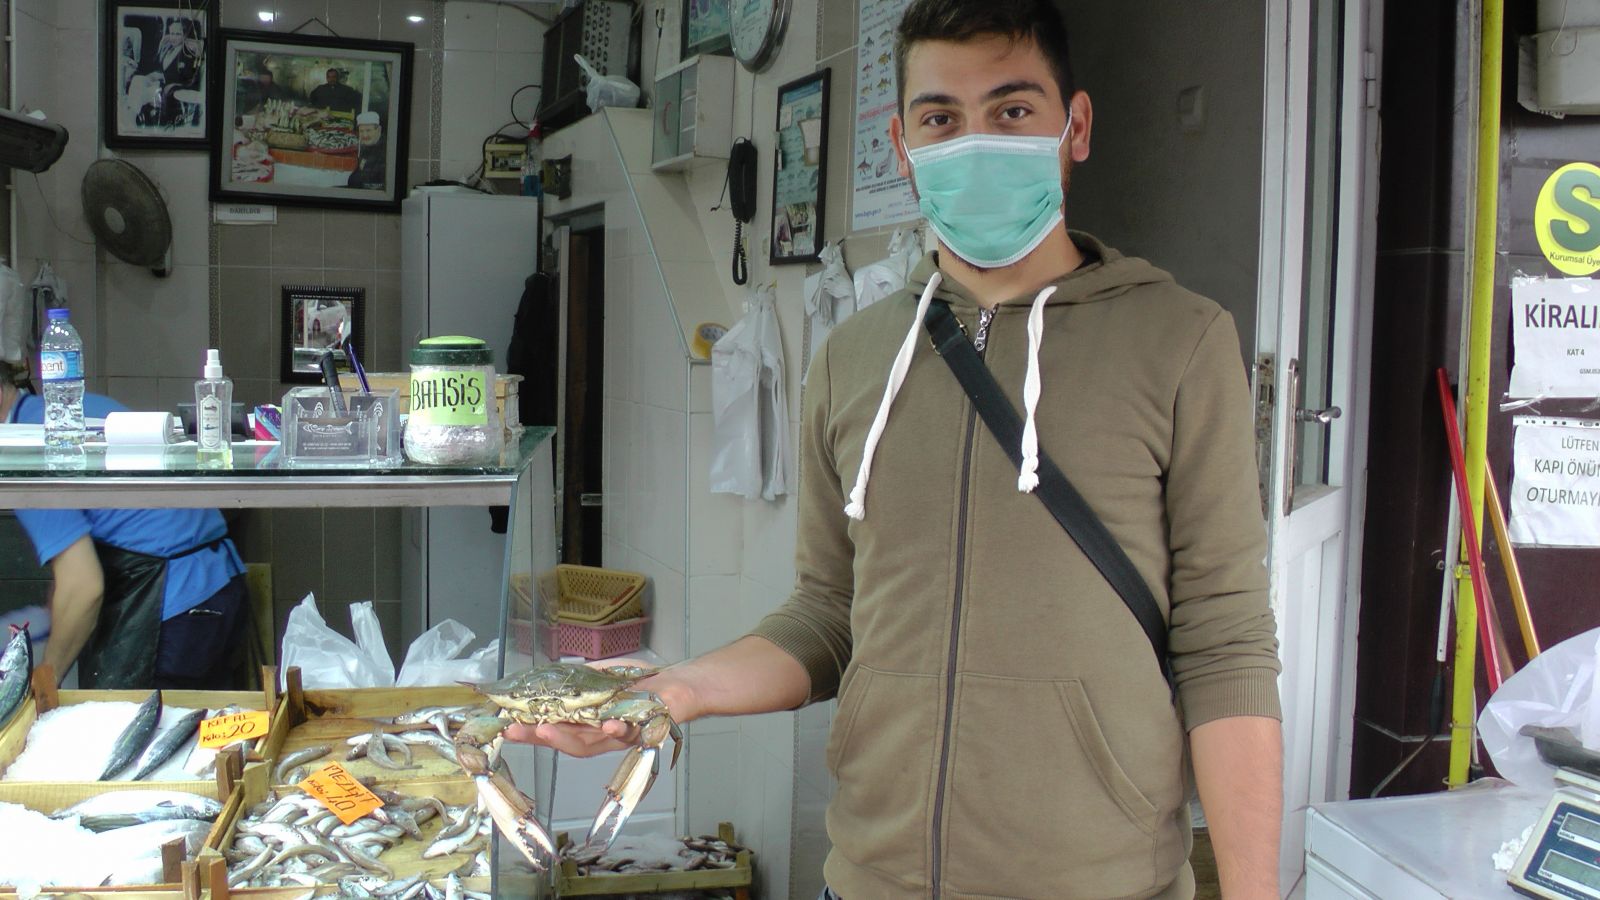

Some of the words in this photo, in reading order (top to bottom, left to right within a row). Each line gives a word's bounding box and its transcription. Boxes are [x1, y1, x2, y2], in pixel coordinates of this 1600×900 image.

[1549, 169, 1600, 252] S
[1549, 251, 1585, 264] Kurumsal
[1586, 254, 1600, 266] Üye
[1525, 298, 1600, 328] KİRALI
[1567, 348, 1579, 356] KAT
[1580, 348, 1585, 356] 4
[1561, 435, 1600, 452] LÜTFEN
[1534, 458, 1564, 475] KAPI
